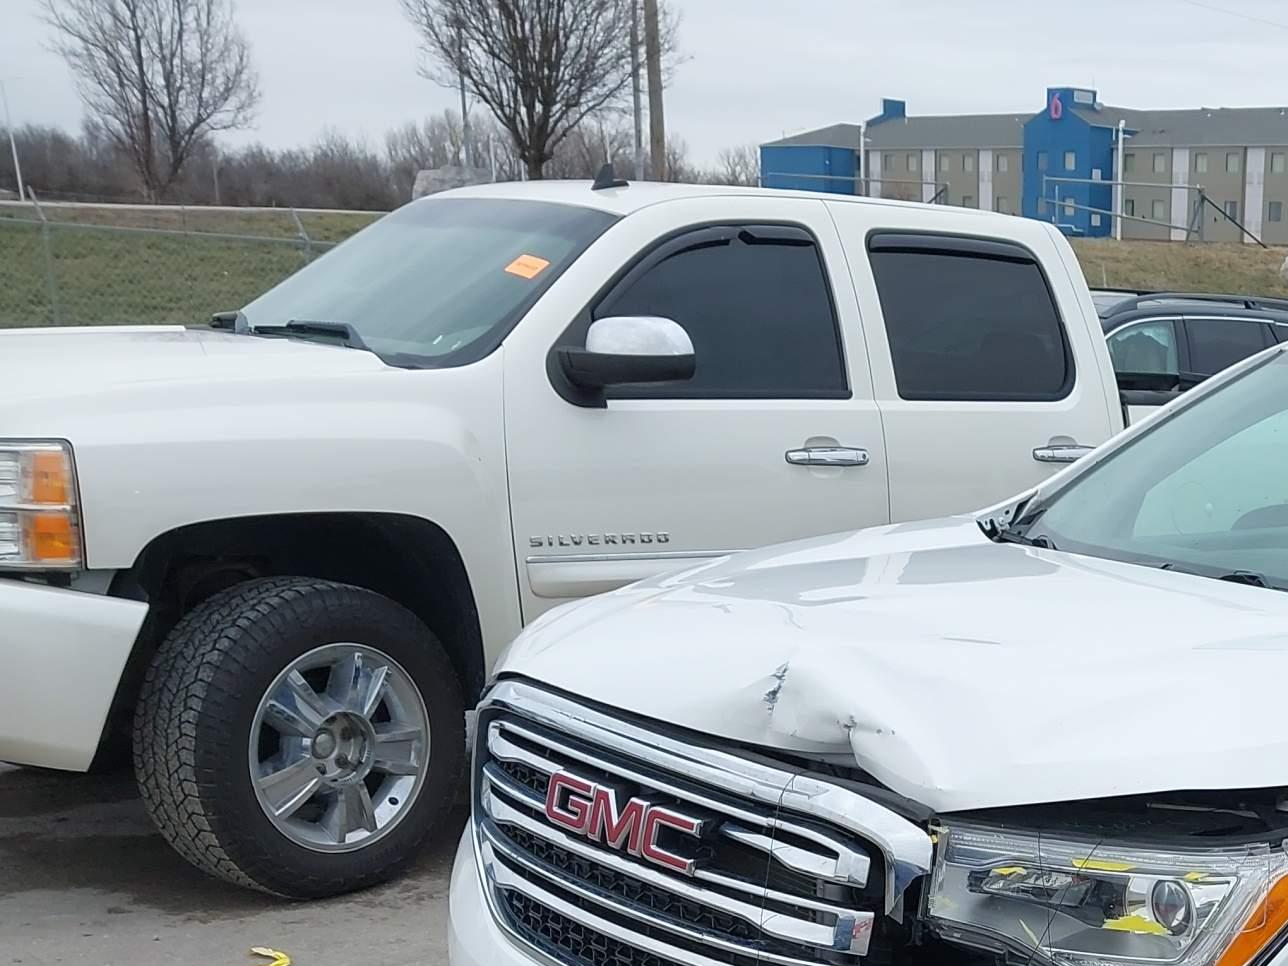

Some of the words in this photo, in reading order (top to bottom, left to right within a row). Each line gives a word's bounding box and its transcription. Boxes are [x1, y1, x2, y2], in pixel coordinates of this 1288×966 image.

[1050, 92, 1062, 119] 6
[529, 532, 670, 548] SILVERADO
[545, 770, 703, 877] GMC
